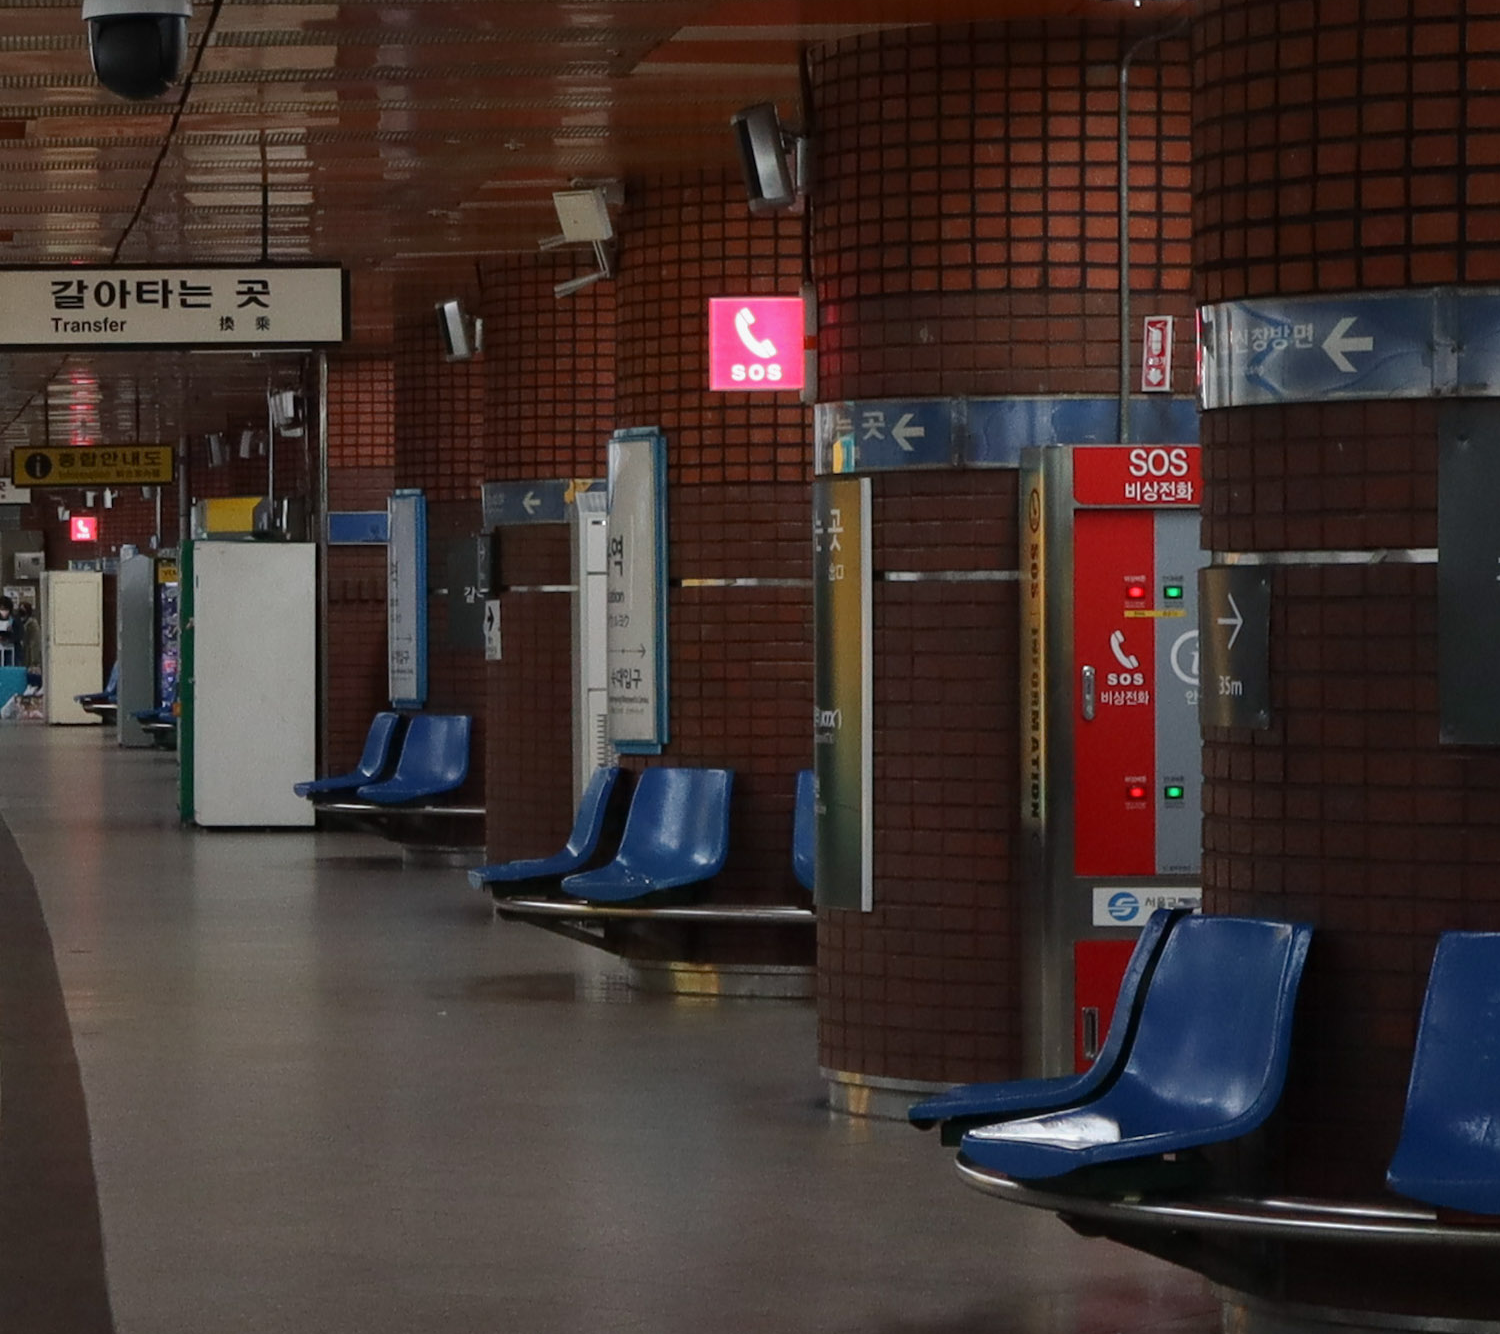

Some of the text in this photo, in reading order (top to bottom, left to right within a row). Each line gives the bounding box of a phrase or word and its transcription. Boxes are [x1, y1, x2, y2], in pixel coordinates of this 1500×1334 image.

[51, 278, 272, 310] 갈아타는 곳
[51, 317, 127, 334] Transfer
[731, 363, 782, 391] SOS
[58, 451, 163, 468] 종합안내도
[1128, 448, 1189, 478] SOS
[1124, 480, 1194, 502] 비상전화
[828, 508, 844, 552] 곳
[1107, 672, 1145, 686] SOS
[1218, 675, 1244, 697] 35m
[1100, 690, 1150, 706] 비상전화
[1185, 690, 1199, 705] 안
